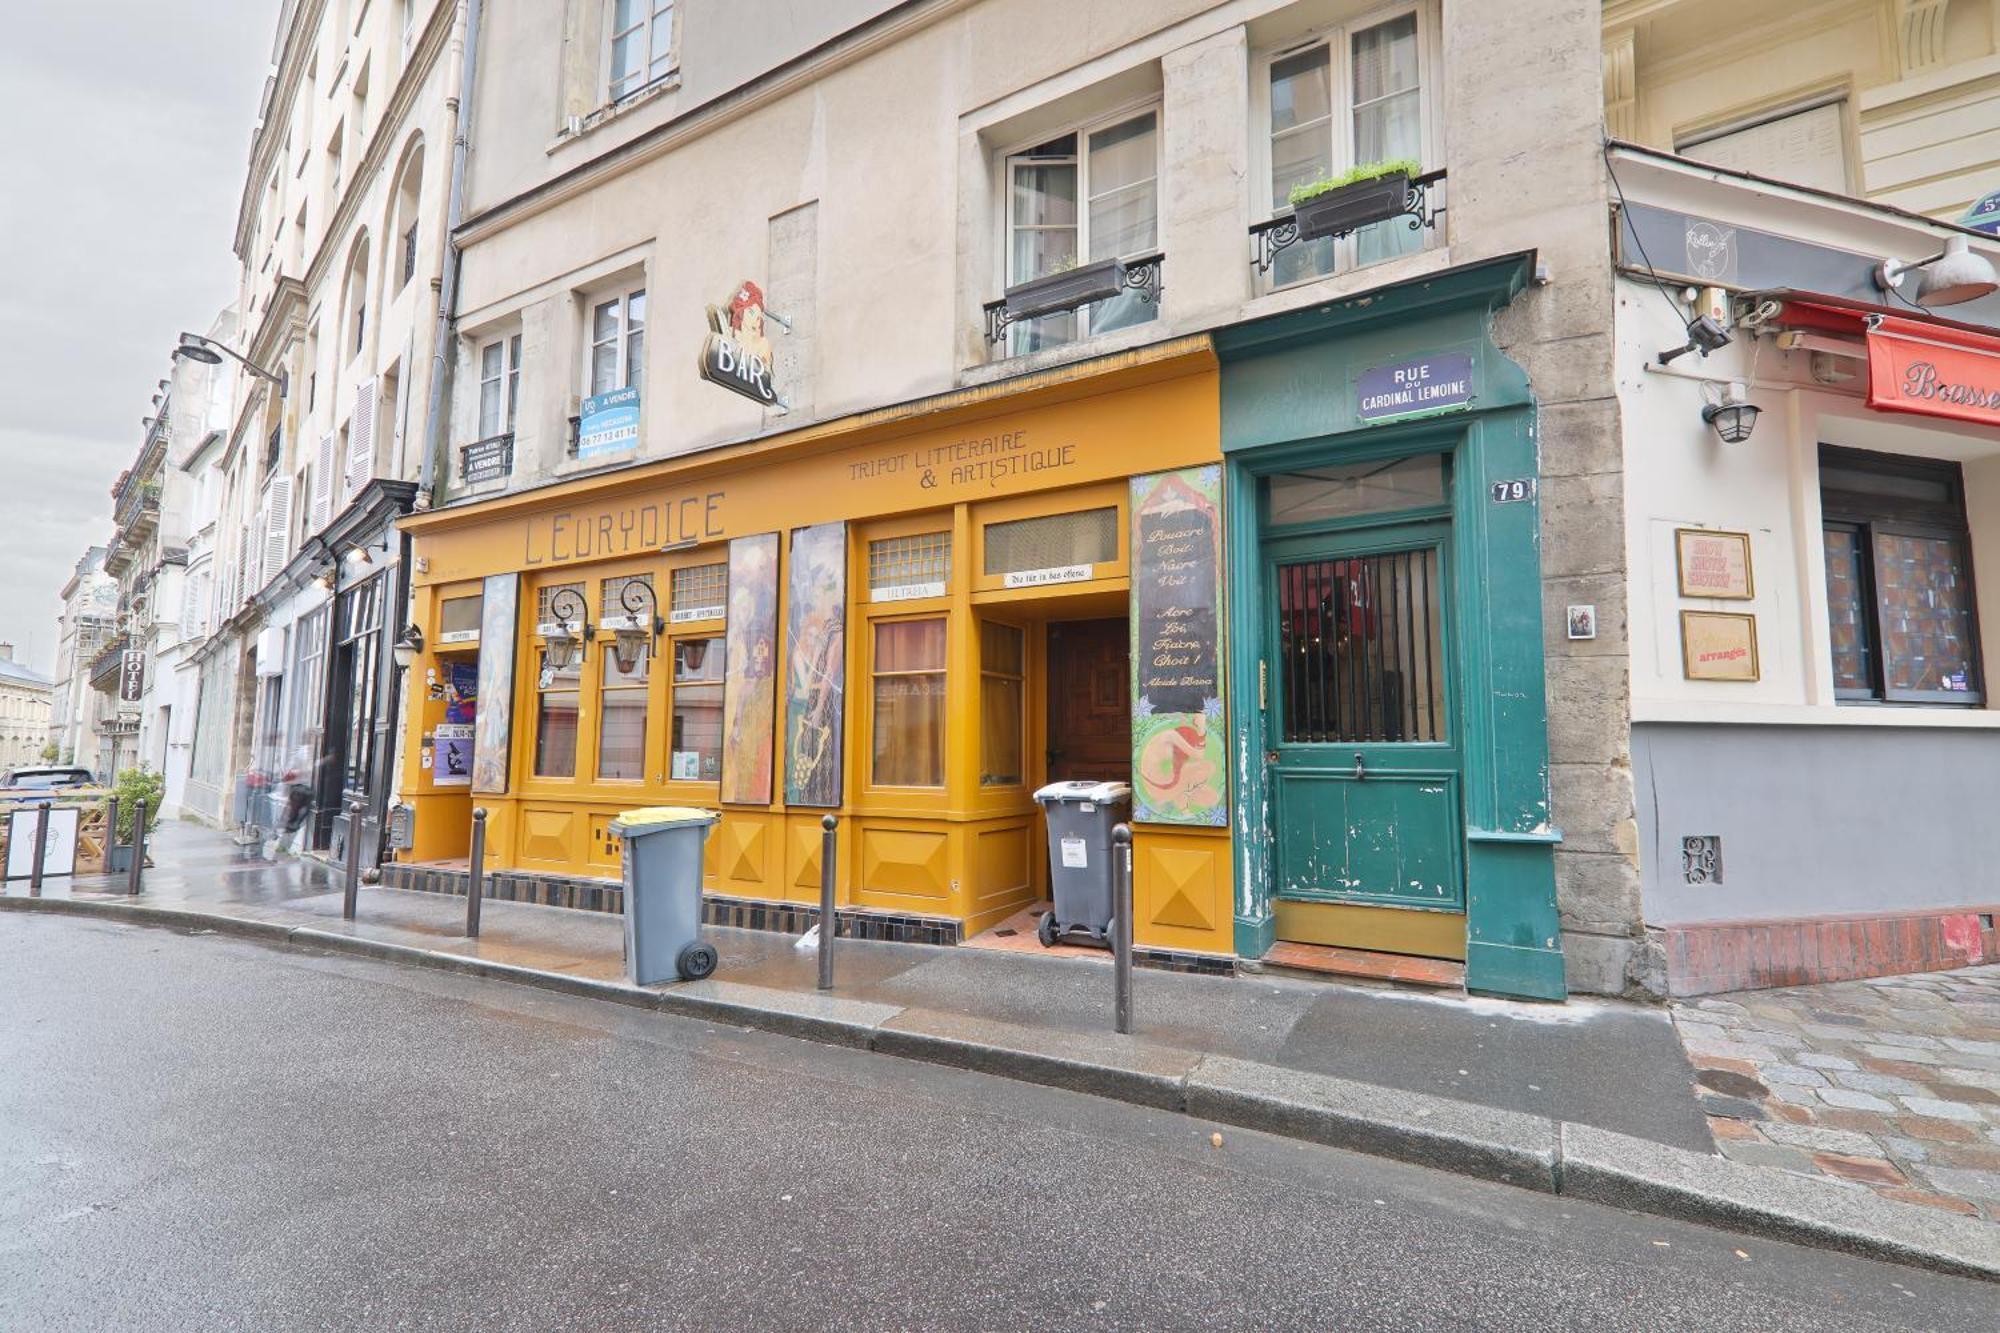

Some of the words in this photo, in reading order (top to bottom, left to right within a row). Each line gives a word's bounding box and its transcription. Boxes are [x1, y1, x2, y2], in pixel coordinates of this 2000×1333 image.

[718, 339, 772, 399] BAR
[1394, 365, 1430, 384] RUE
[609, 390, 636, 403] VENDRE
[1363, 389, 1415, 411] CARDINAL
[1418, 380, 1466, 401] LEMOINE
[1405, 381, 1421, 390] DU
[474, 456, 501, 470] VENDRE
[848, 454, 908, 480] TRIPOT
[915, 430, 1026, 468] LITTÉRAIRE
[920, 468, 938, 489] &
[951, 444, 1076, 488] ARTISTIQUE
[1498, 482, 1523, 500] 79
[126, 652, 142, 701] HOTEL
